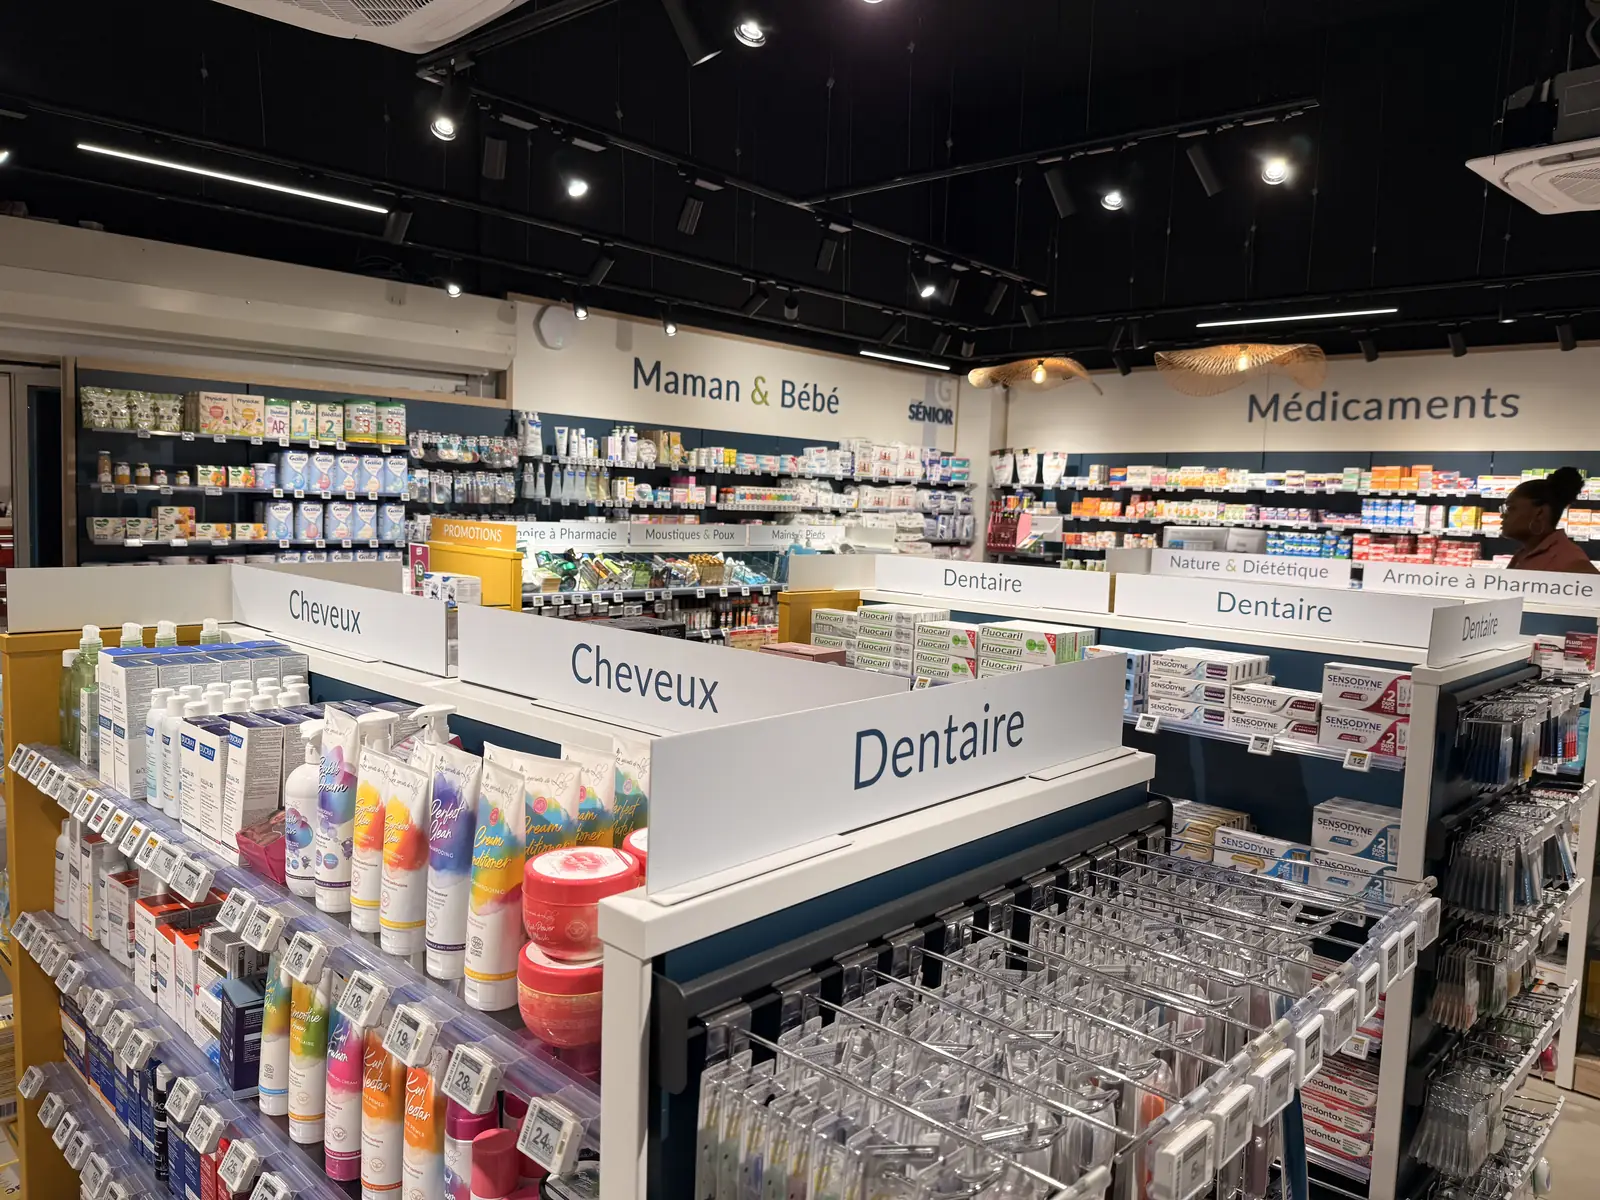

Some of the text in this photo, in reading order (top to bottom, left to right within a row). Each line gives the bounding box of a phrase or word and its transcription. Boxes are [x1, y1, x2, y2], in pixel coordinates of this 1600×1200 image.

[633, 357, 839, 414] Maman & Bébé
[1247, 387, 1520, 423] Médicaments
[908, 401, 953, 426] SÉNIOR
[272, 420, 286, 434] AR
[302, 418, 308, 434] 1
[325, 420, 335, 434] 2
[363, 419, 371, 434] 3
[394, 421, 401, 436] 3
[443, 524, 502, 542] PROMOTIONS
[516, 527, 617, 540] moire à Pharmacie
[645, 528, 735, 542] Moustiques & Poux
[772, 529, 795, 540] Mains
[806, 529, 826, 540] Pieds
[415, 564, 424, 576] 15
[1170, 556, 1329, 580] Nature & Diététique
[944, 568, 1022, 593] Dentaire
[1383, 568, 1593, 598] Armoire à Pharmacie
[289, 589, 361, 635] Cheveux
[1217, 591, 1332, 623] Dentaire
[815, 612, 844, 623] Fluocaril
[859, 610, 893, 622] Fluocaril
[859, 625, 893, 637] Fluocaril
[917, 625, 951, 637] Fluocaril
[981, 627, 1024, 640] Fluocaril
[1462, 615, 1499, 641] Dentaire
[814, 636, 843, 647] Fluocaril
[857, 641, 891, 653] Fluocaril
[917, 638, 950, 650] Fluocaril
[981, 643, 1023, 656] Fluocaril
[856, 656, 891, 668] Fluocaril
[916, 653, 950, 664] Fluocaril
[981, 659, 1023, 672] Fluocaril
[1152, 660, 1188, 670] SENSODYNE
[571, 642, 719, 714] Cheveux
[916, 665, 950, 678] Fluocaril
[1150, 682, 1187, 692] SENSODYNE
[1327, 674, 1383, 689] SENSODYNE
[1232, 693, 1277, 707] SENSODYNE
[1150, 703, 1187, 714] SENSODYNE
[1231, 716, 1278, 729] SENSODYNE
[1325, 715, 1382, 731] SENSODYNE
[200, 744, 215, 757] DUCRAY
[854, 702, 1025, 790] Dentaire
[1353, 757, 1365, 766] 12
[430, 798, 465, 825] Perfect
[429, 820, 453, 842] Clean
[1317, 817, 1373, 836] SENSODYNE
[475, 826, 504, 849] Cream
[1221, 836, 1276, 856] SENSODYNE
[1372, 847, 1386, 855] DUO
[472, 848, 512, 869] nditioner
[226, 905, 237, 921] 21
[251, 922, 263, 939] 18
[291, 951, 305, 969] 18
[1308, 1077, 1348, 1096] rodontax
[405, 1093, 431, 1122] Nectar
[1301, 1102, 1343, 1123] arodontax
[194, 1124, 206, 1141] 27
[1304, 1126, 1341, 1145] rodontax
[226, 1160, 238, 1177] 25
